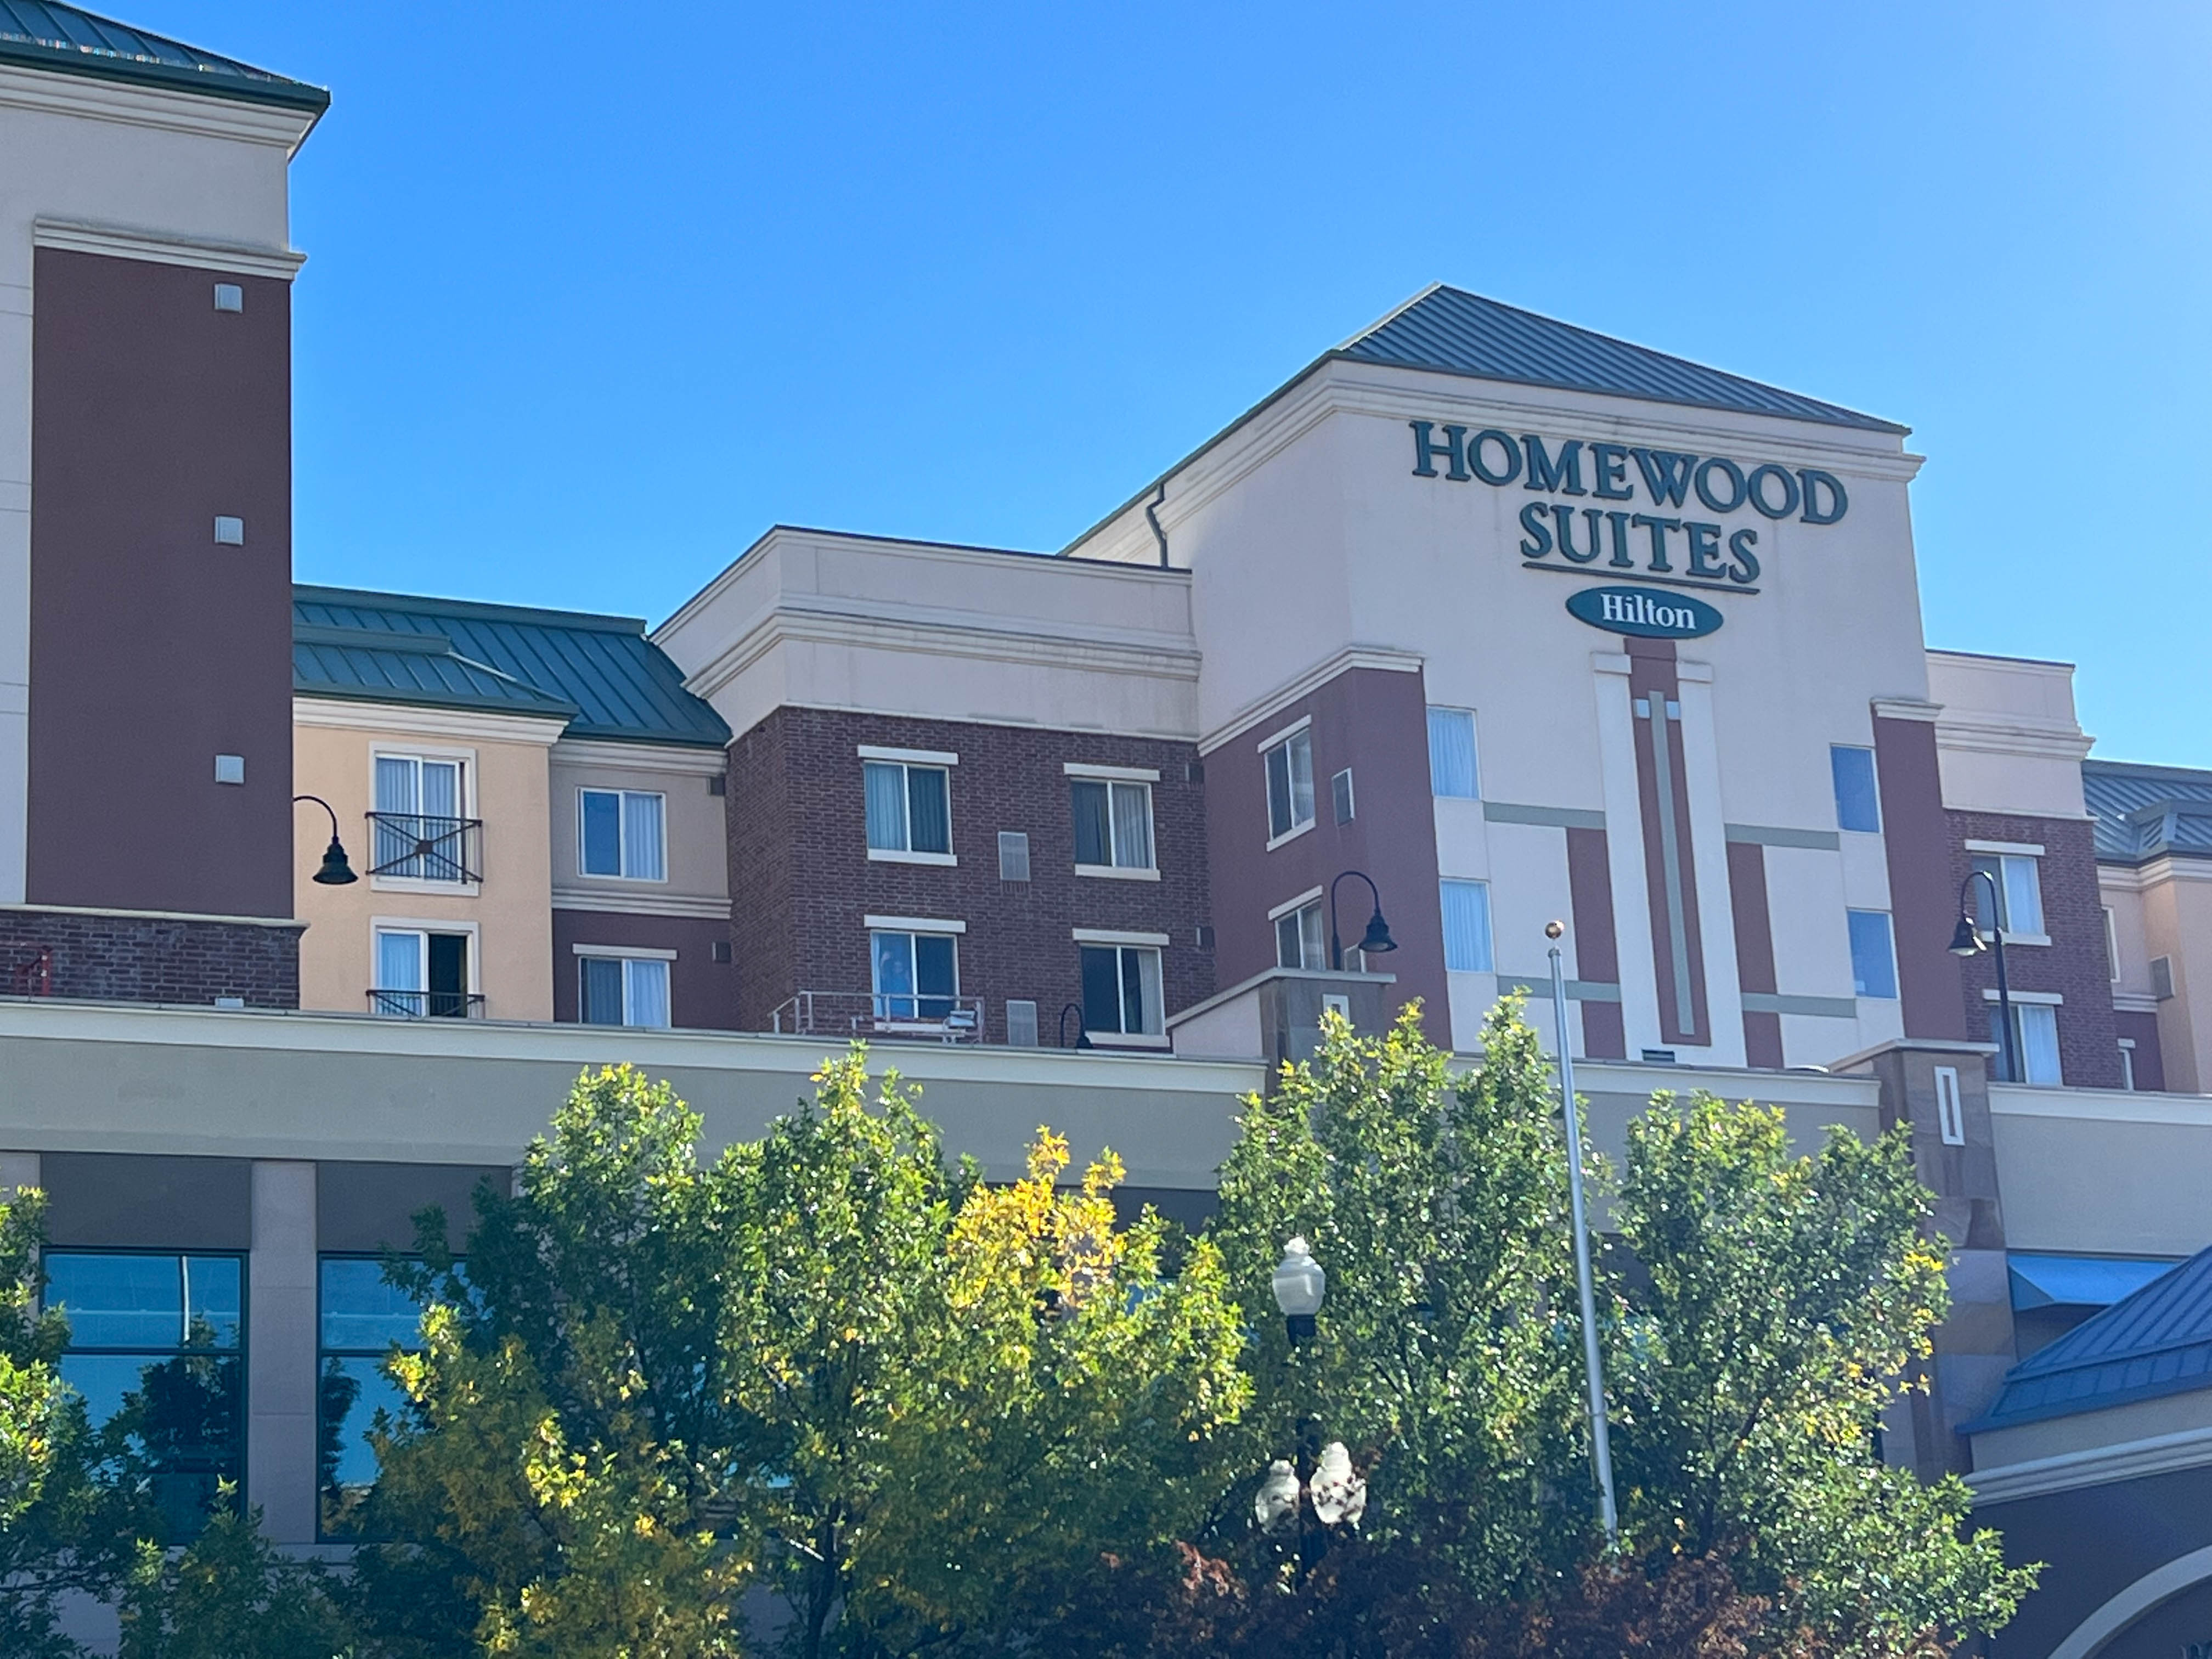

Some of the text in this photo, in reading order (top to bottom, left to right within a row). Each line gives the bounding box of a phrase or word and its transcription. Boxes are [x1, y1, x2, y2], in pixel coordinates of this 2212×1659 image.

[1409, 421, 1848, 525] HOMEWOOD
[1519, 502, 1760, 583] SUITES
[1600, 594, 1696, 629] Hilton
